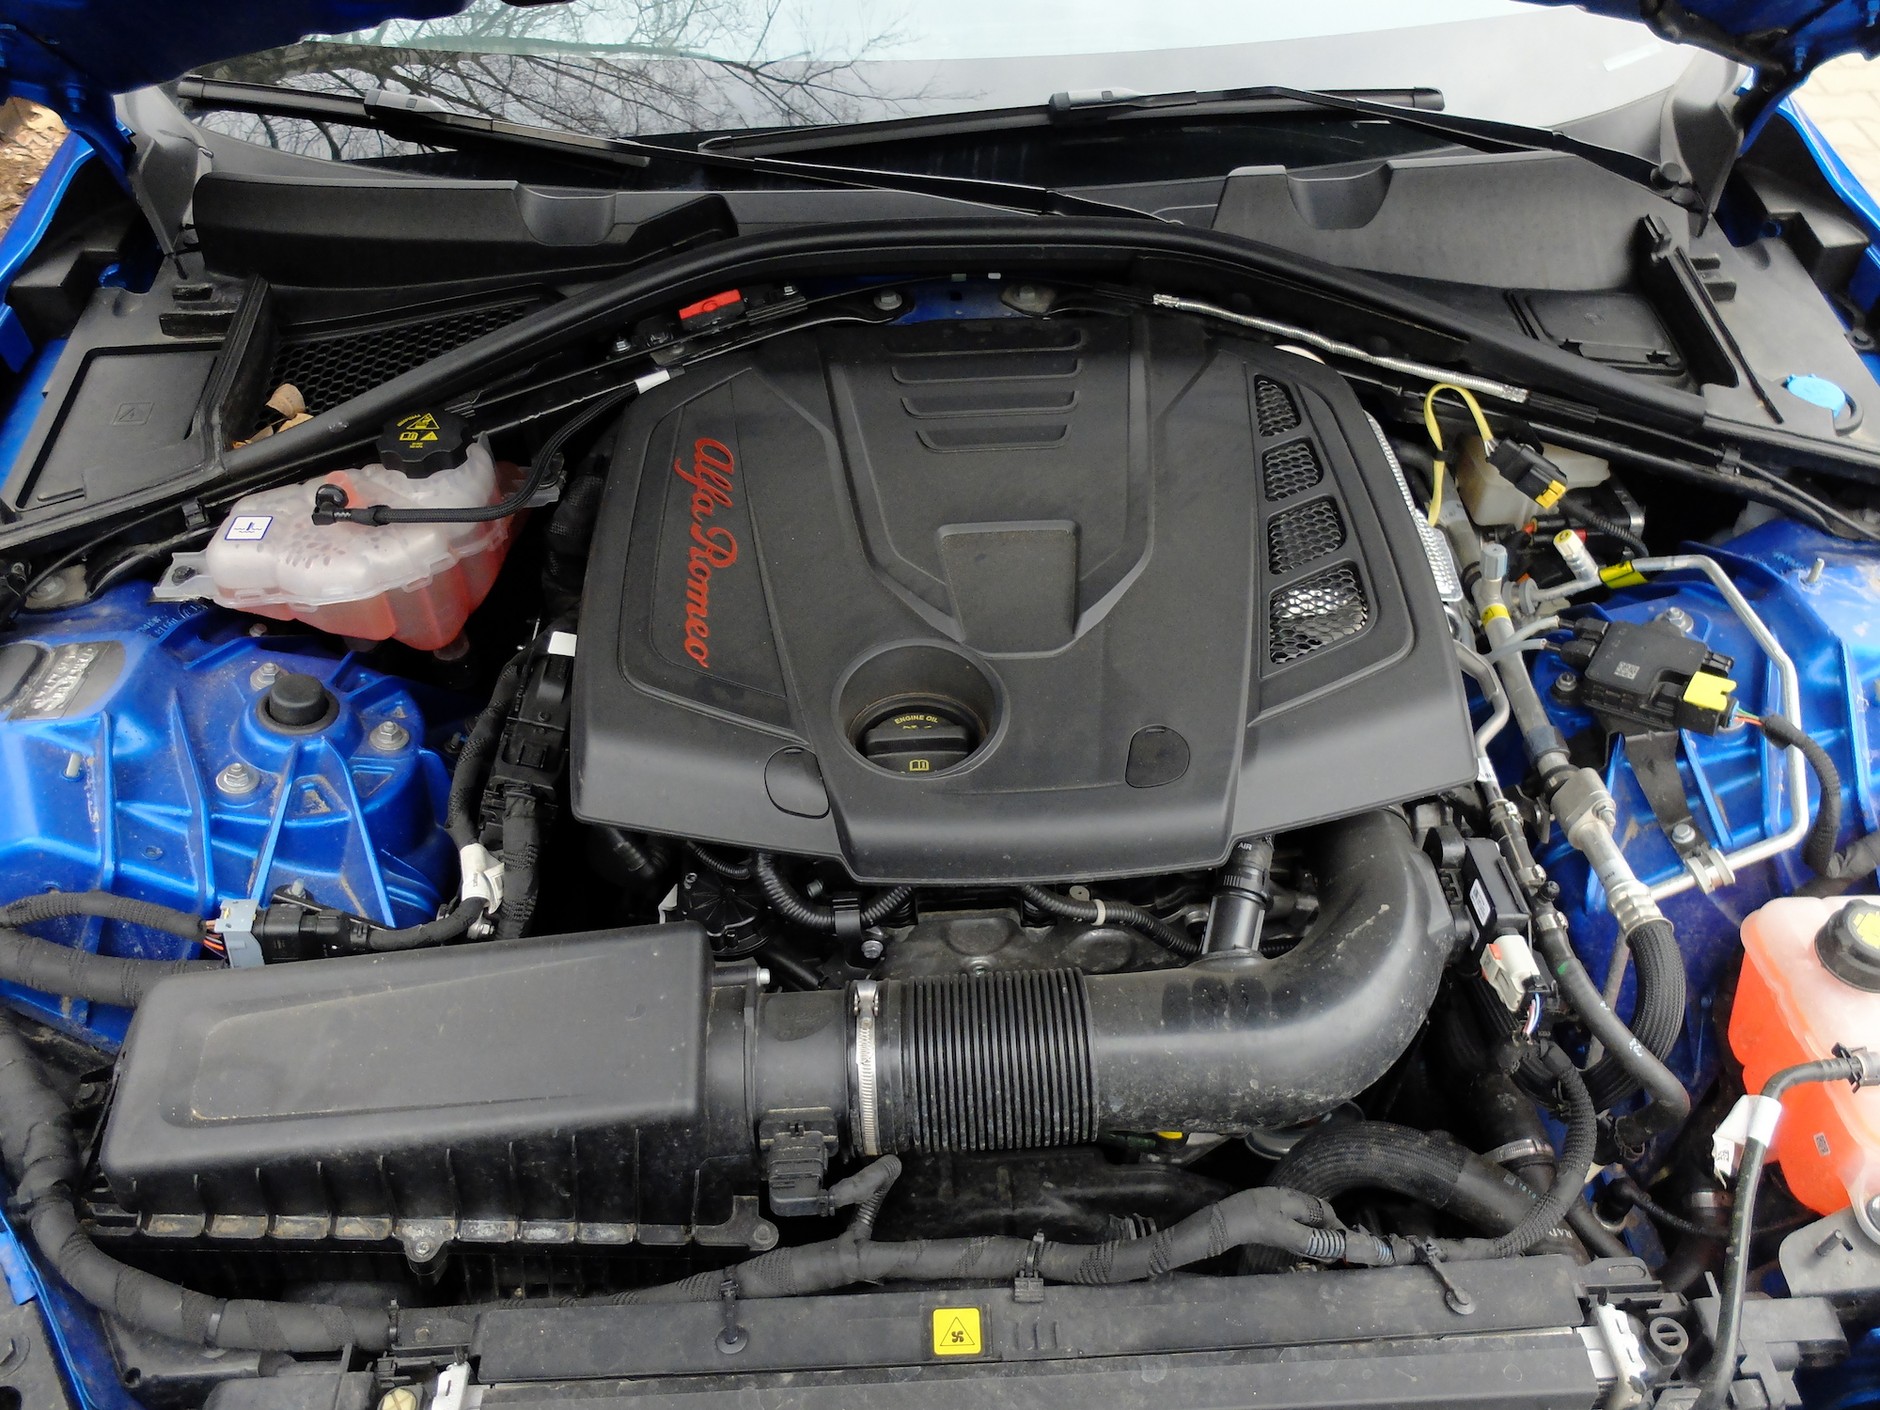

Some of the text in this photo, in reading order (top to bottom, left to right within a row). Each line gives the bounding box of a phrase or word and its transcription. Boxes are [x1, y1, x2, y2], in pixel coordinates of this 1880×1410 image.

[674, 437, 738, 668] Alfa Romeo
[894, 714, 939, 725] ENGINE OIL
[1237, 841, 1253, 851] AIR
